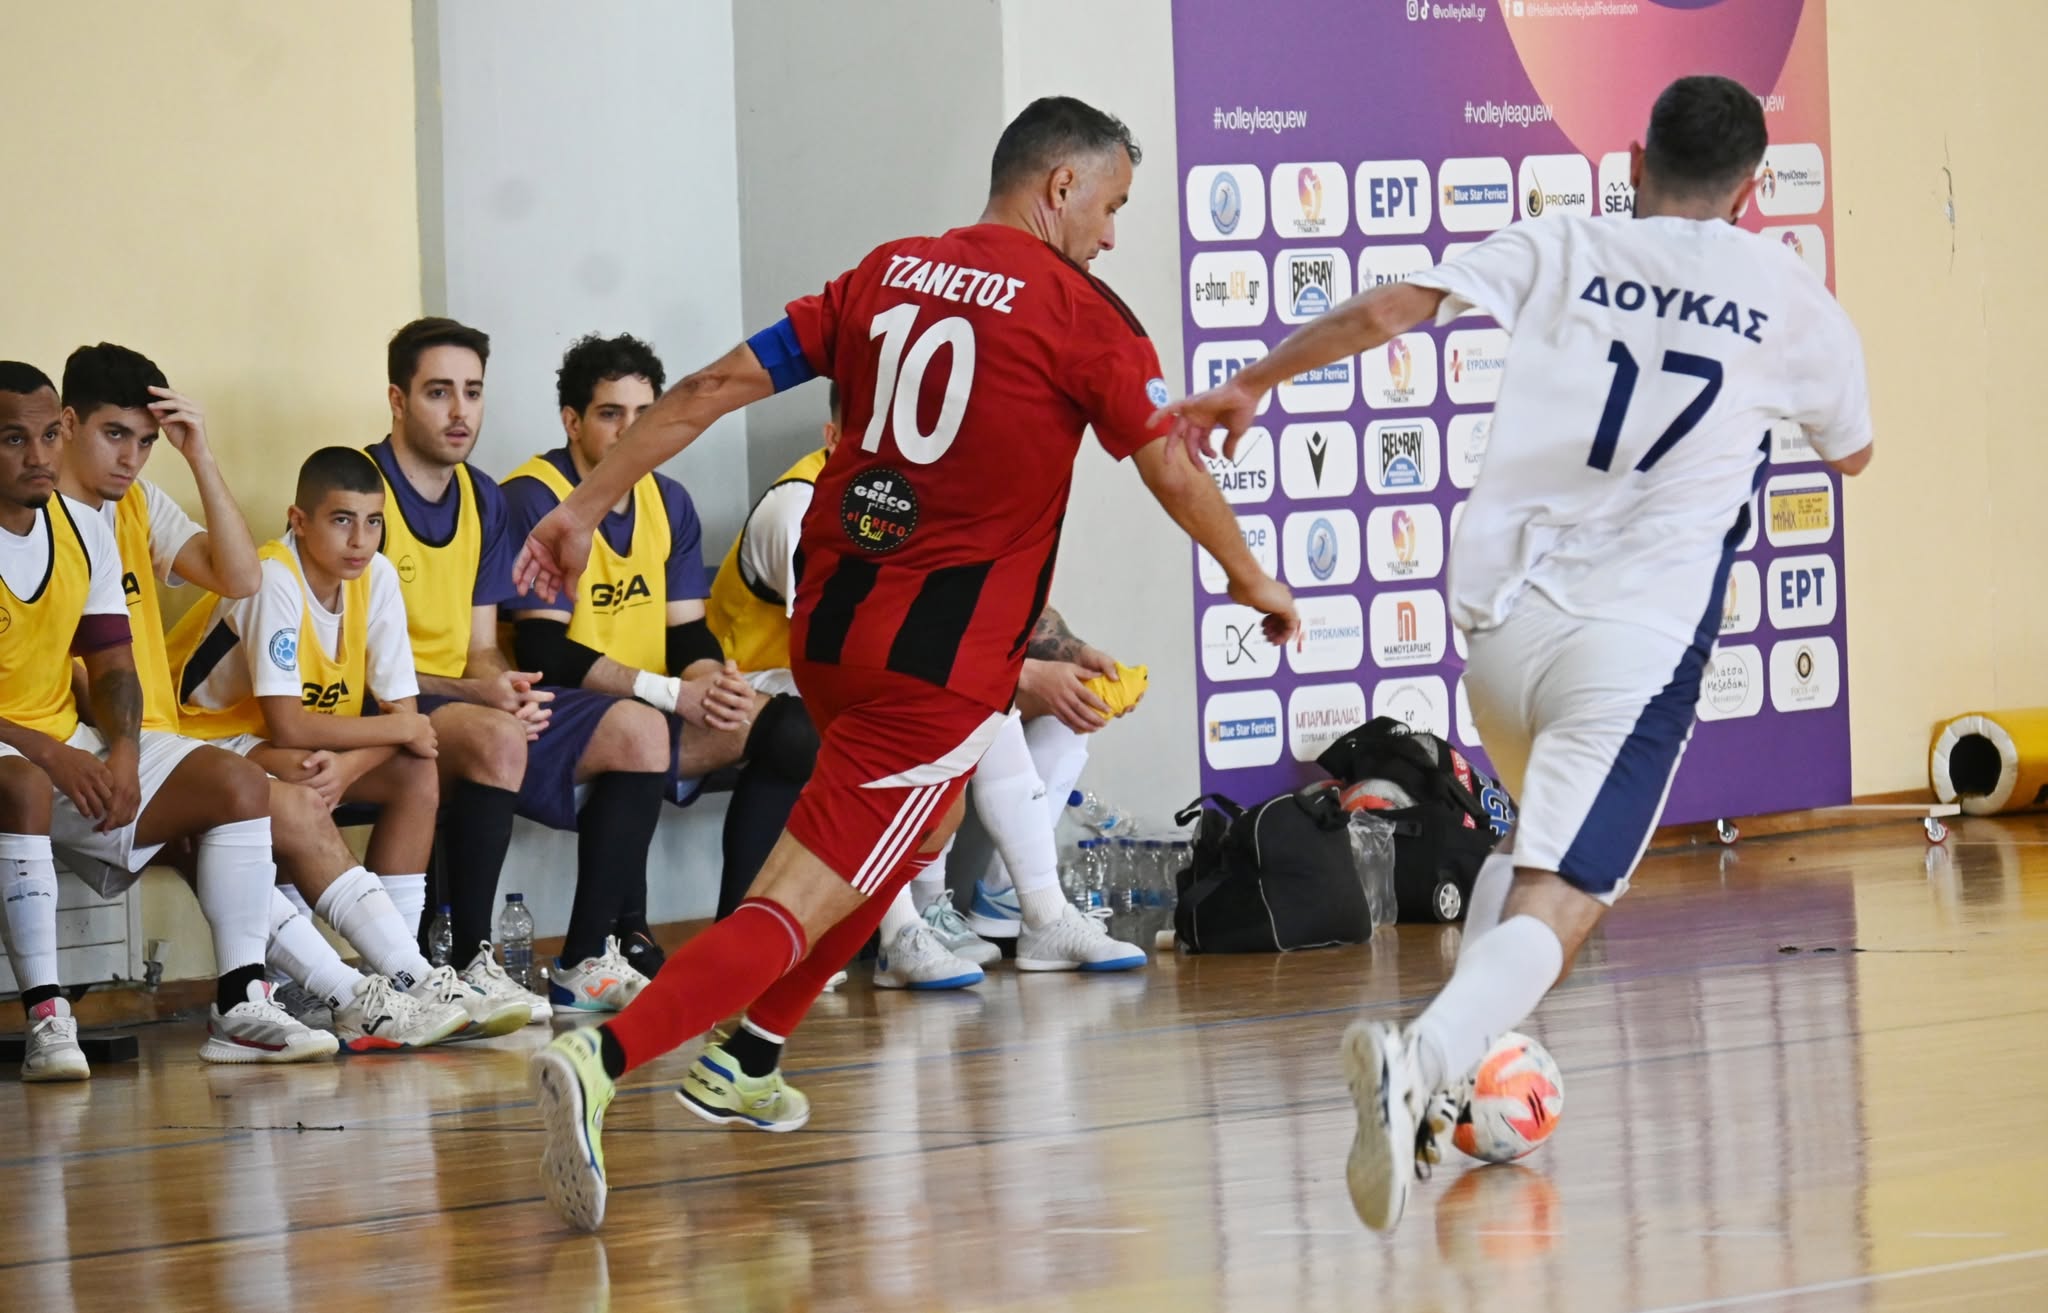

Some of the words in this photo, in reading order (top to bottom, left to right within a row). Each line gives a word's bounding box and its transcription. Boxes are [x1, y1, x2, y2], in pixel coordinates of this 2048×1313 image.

[1432, 4, 1487, 22] @volleyball.gr
[1213, 106, 1307, 134] #volleyleaguew
[1464, 100, 1554, 128] #volleyleaguew
[1370, 177, 1418, 218] ΕΡΤ
[1454, 189, 1468, 201] Blue
[1470, 188, 1483, 200] Star
[1484, 187, 1507, 200] Ferries
[1546, 193, 1585, 206] PROGAIA
[881, 254, 1025, 314] ΤΖΑΝΕΤΟΣ
[1580, 275, 1768, 344] ΔΟΥΚΑΣ
[860, 302, 976, 465] 10
[1586, 339, 1724, 472] 17
[854, 485, 912, 511] GRECO
[1781, 568, 1825, 609] ΕΡΤ
[1220, 724, 1235, 738] Blue
[1236, 723, 1250, 736] Star
[1251, 721, 1274, 735] Ferries
